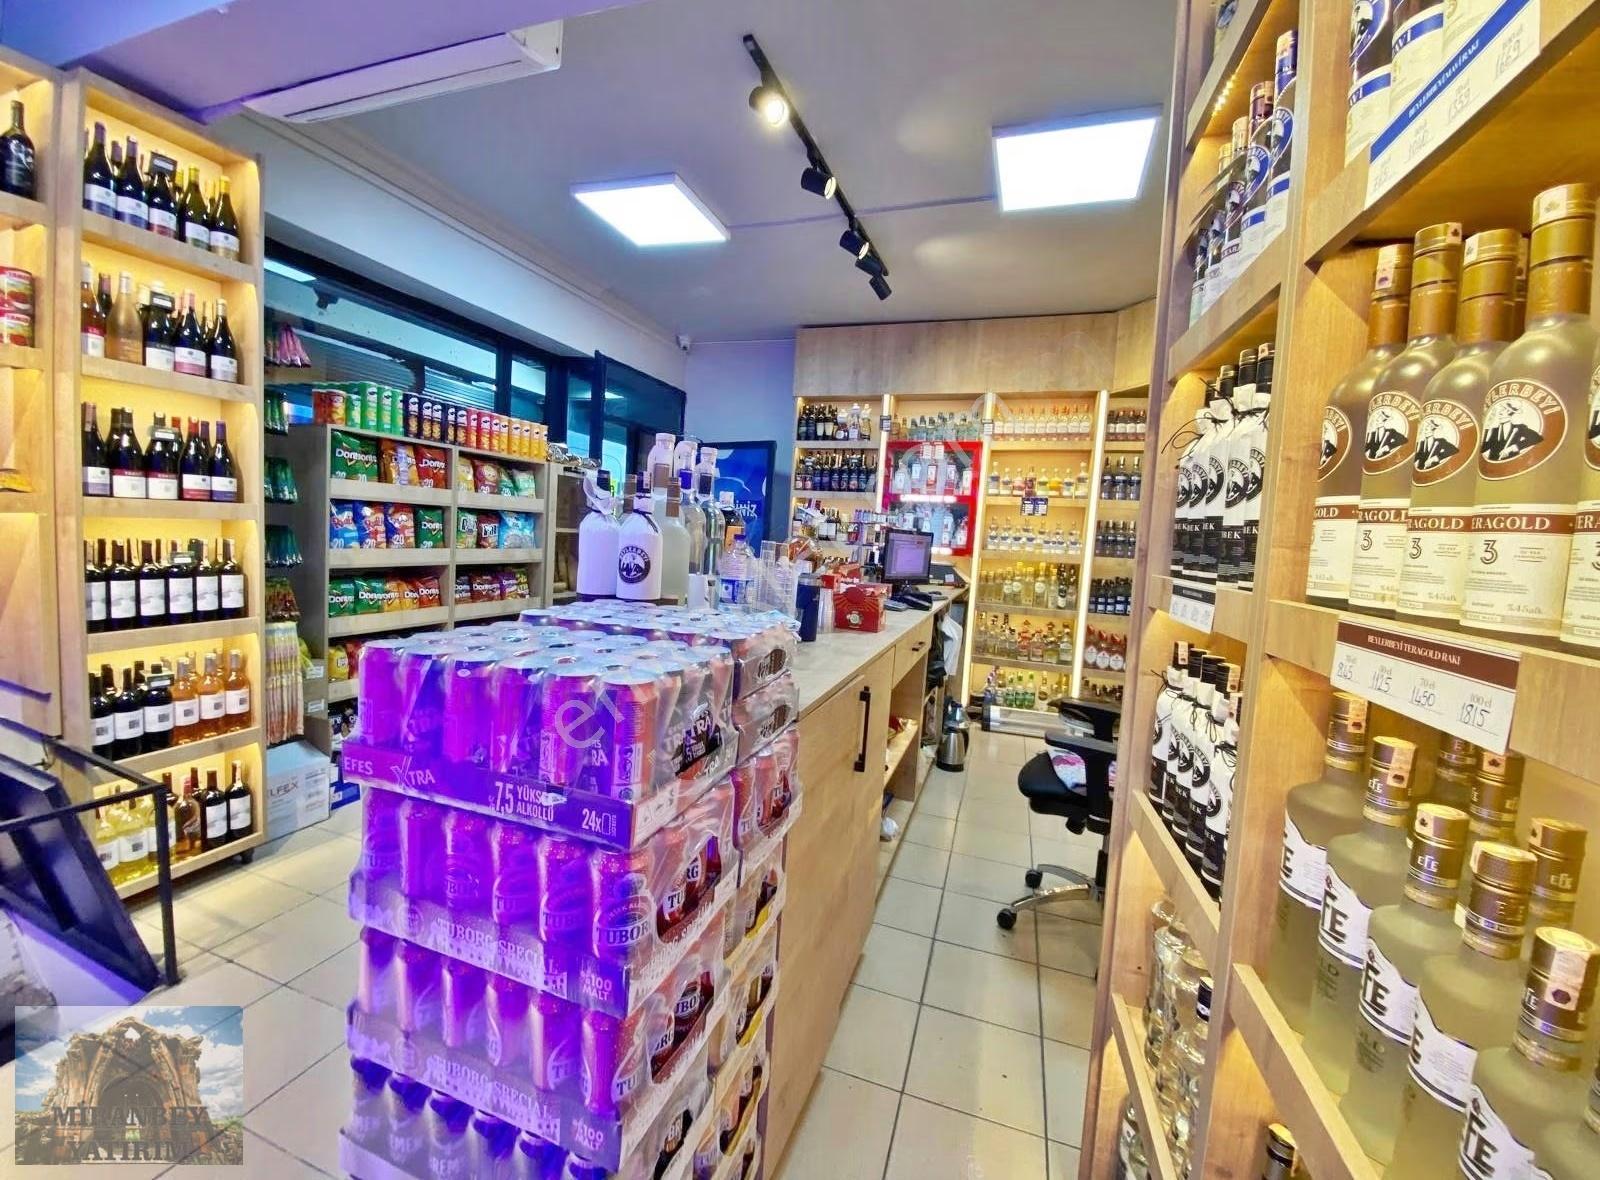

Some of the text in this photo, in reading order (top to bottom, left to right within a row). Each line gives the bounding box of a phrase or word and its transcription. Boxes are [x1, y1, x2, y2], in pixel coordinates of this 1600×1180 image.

[1360, 529, 1373, 552] 3
[1409, 537, 1422, 560] 3
[1480, 539, 1499, 565] 3
[1461, 702, 1491, 728] 1815
[344, 758, 374, 776] EFES
[1417, 855, 1439, 873] EFE
